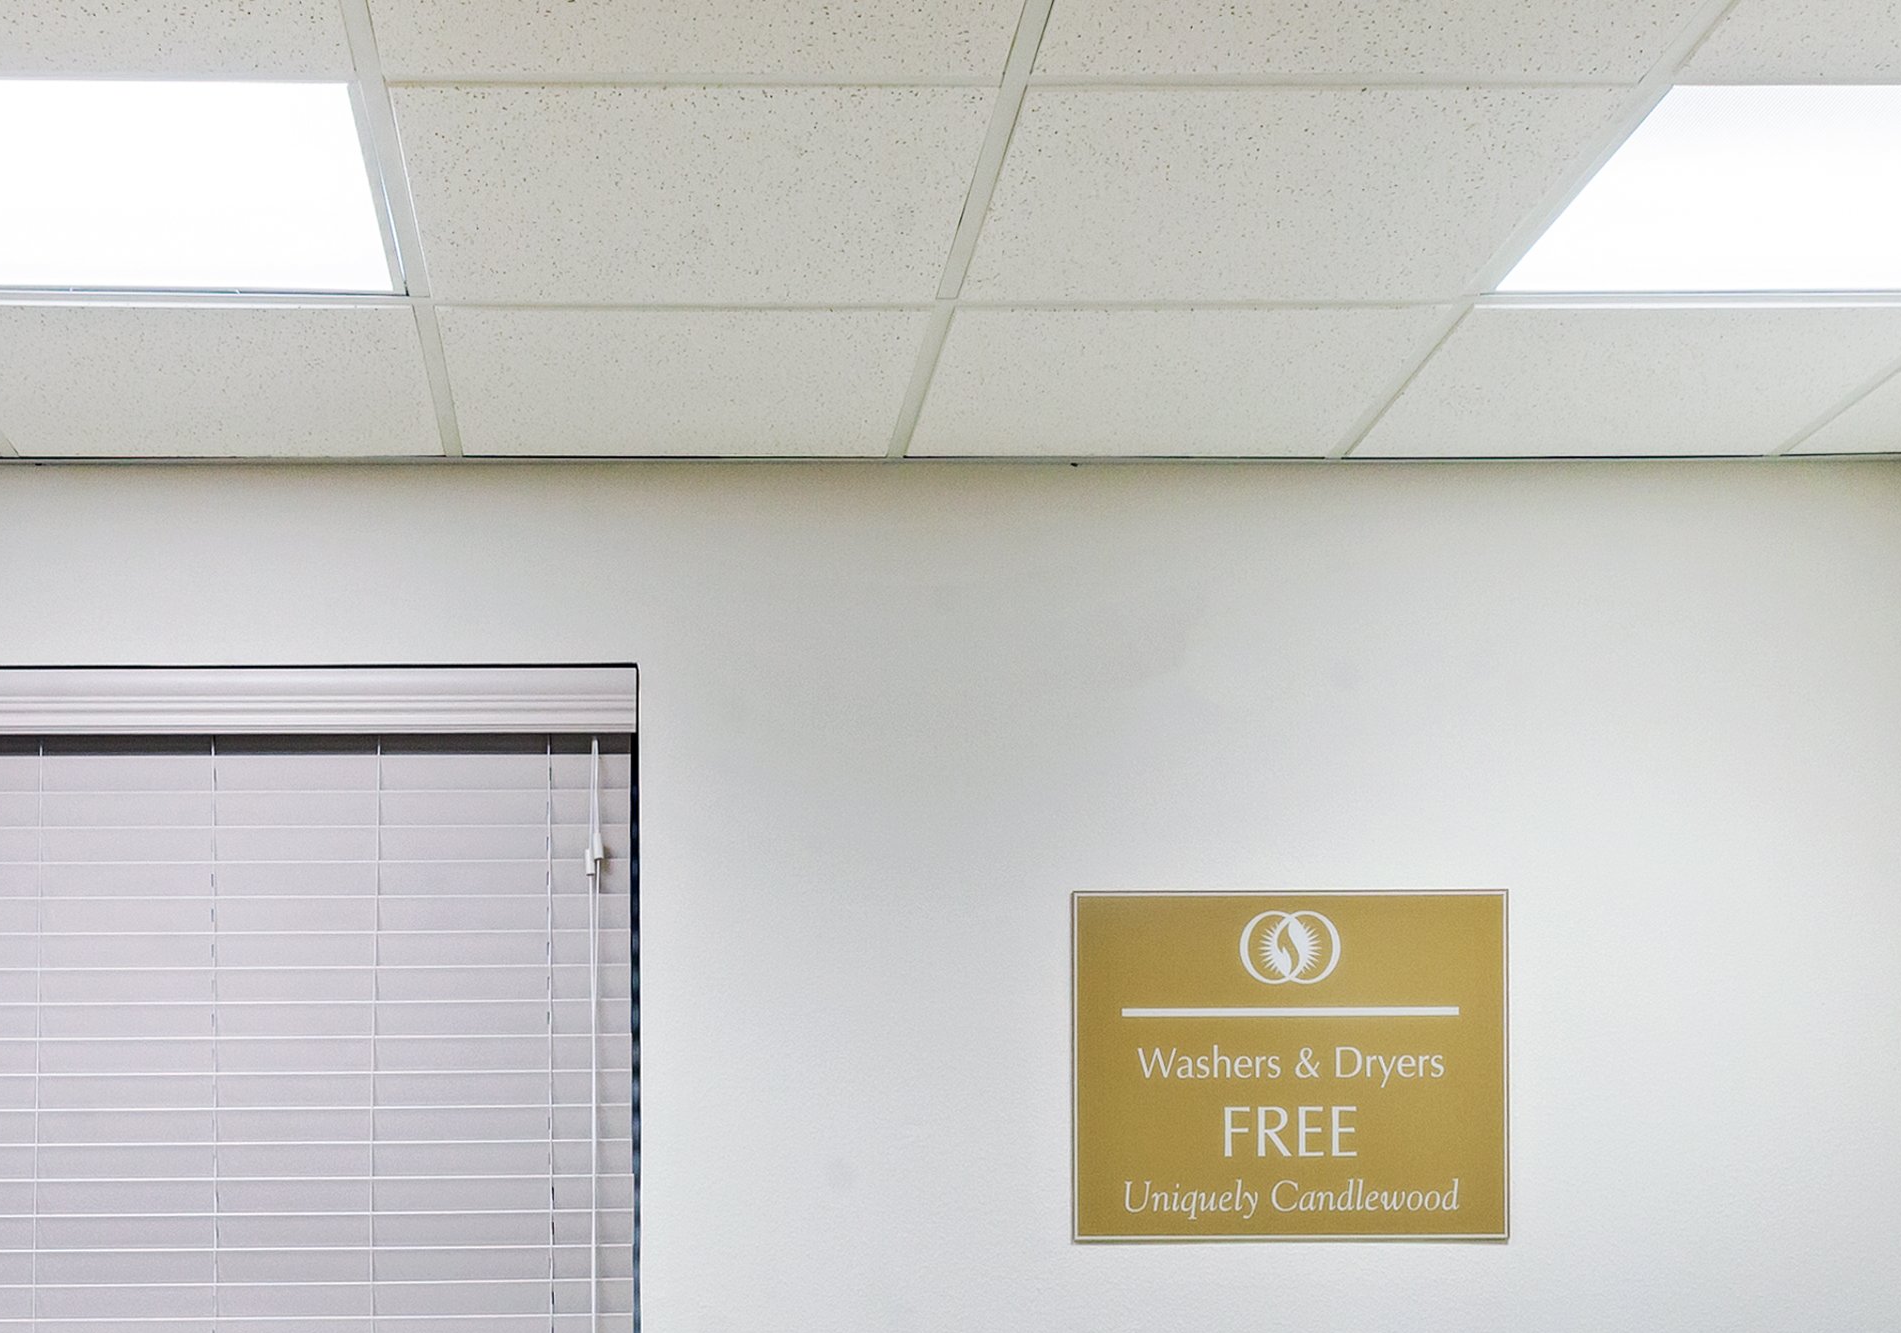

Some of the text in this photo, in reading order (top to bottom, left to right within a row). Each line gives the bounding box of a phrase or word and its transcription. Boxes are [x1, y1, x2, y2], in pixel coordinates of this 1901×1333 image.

[1137, 1045, 1445, 1088] Washers & Dryers
[1223, 1105, 1358, 1158] FREE
[1123, 1178, 1461, 1219] Uniquely Candlewood
